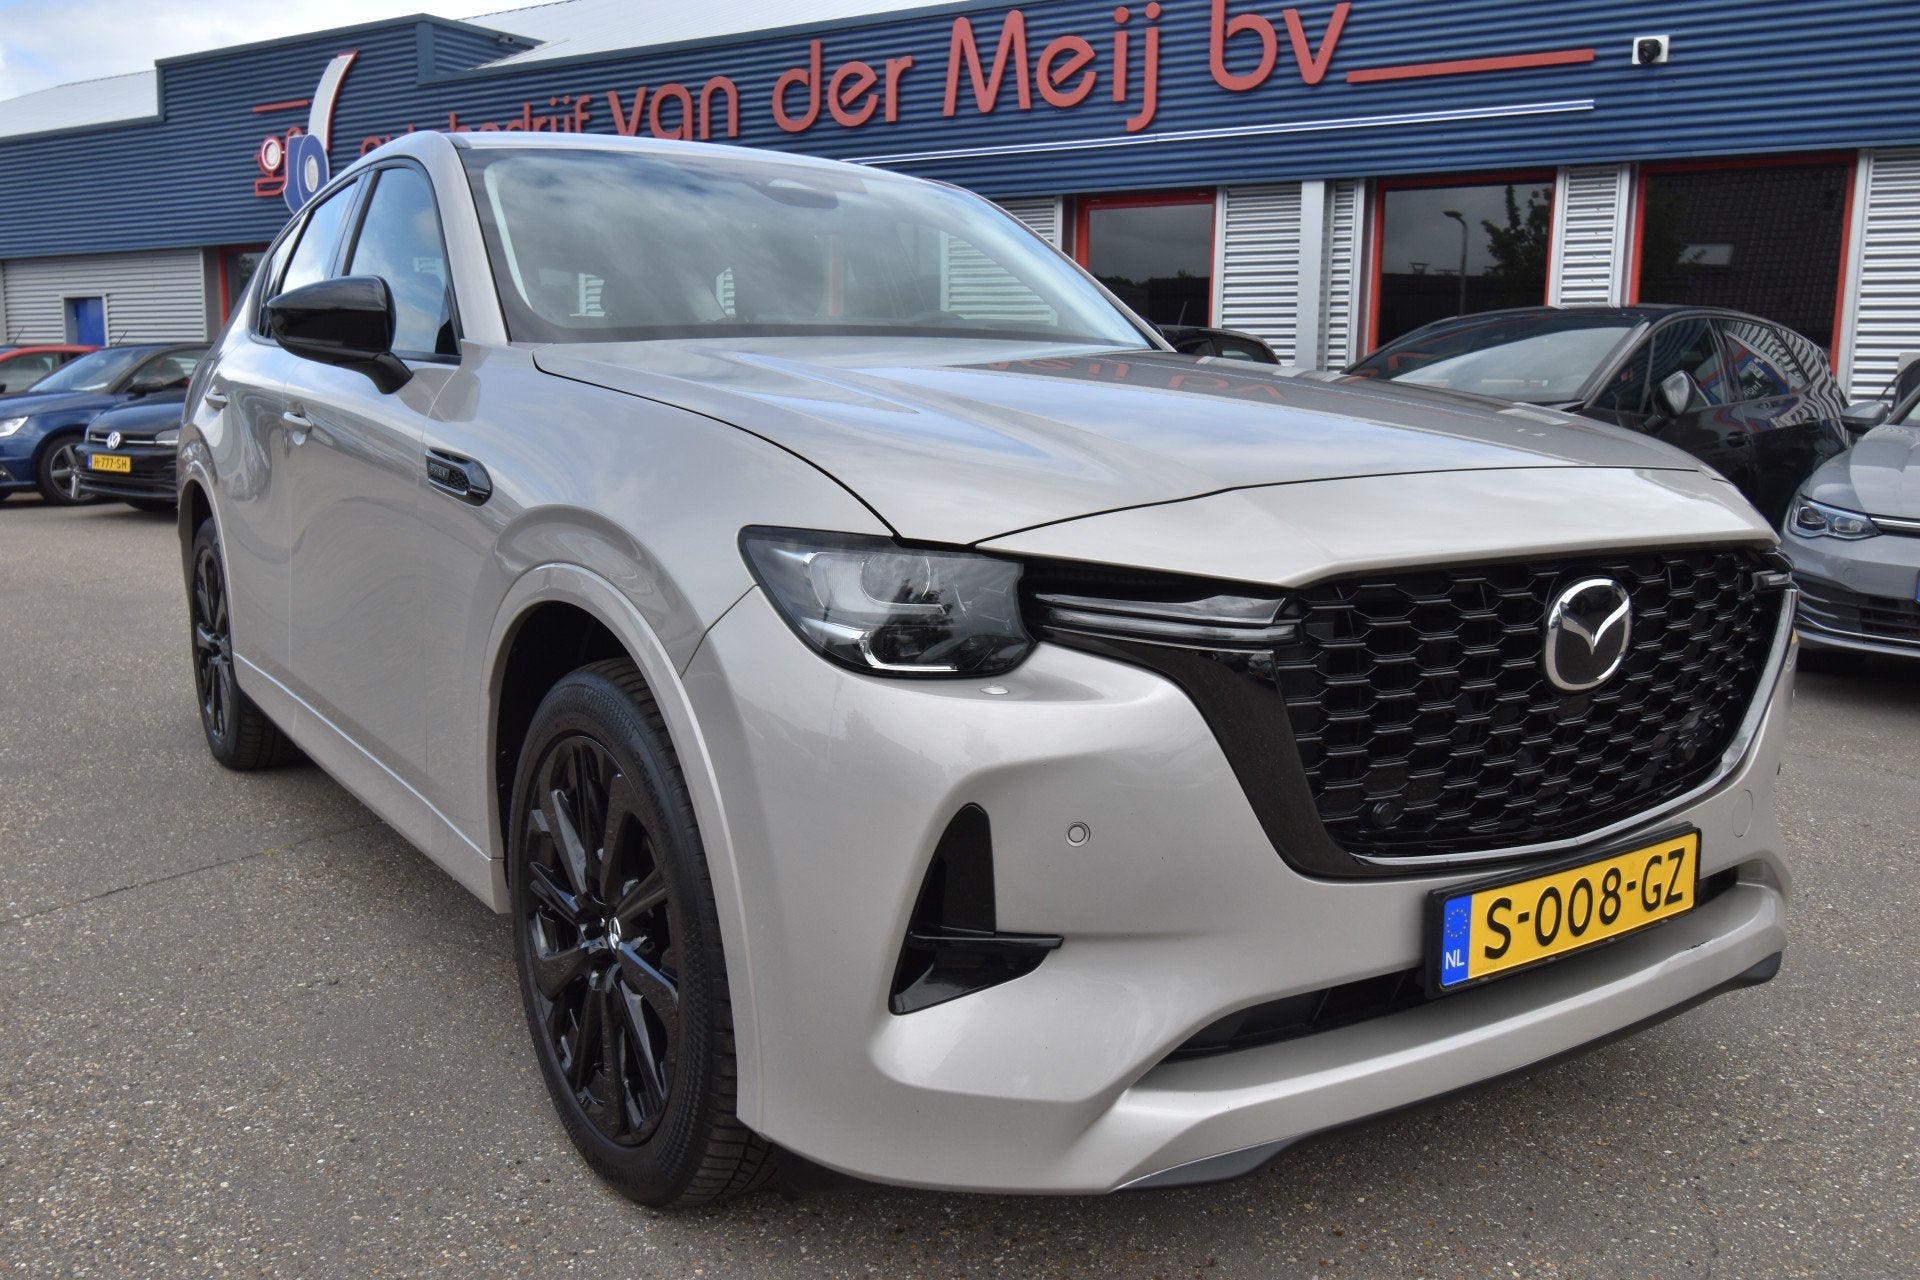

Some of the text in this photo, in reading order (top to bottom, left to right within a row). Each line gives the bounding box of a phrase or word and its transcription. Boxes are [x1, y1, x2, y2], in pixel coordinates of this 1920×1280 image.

[606, 75, 739, 141] van
[771, 39, 913, 132] der
[942, 1, 1161, 132] Meij
[1209, 0, 1352, 92] bv
[94, 456, 127, 470] H-777-SH
[1484, 847, 1686, 960] S-008-GZ
[1445, 948, 1465, 970] NL
